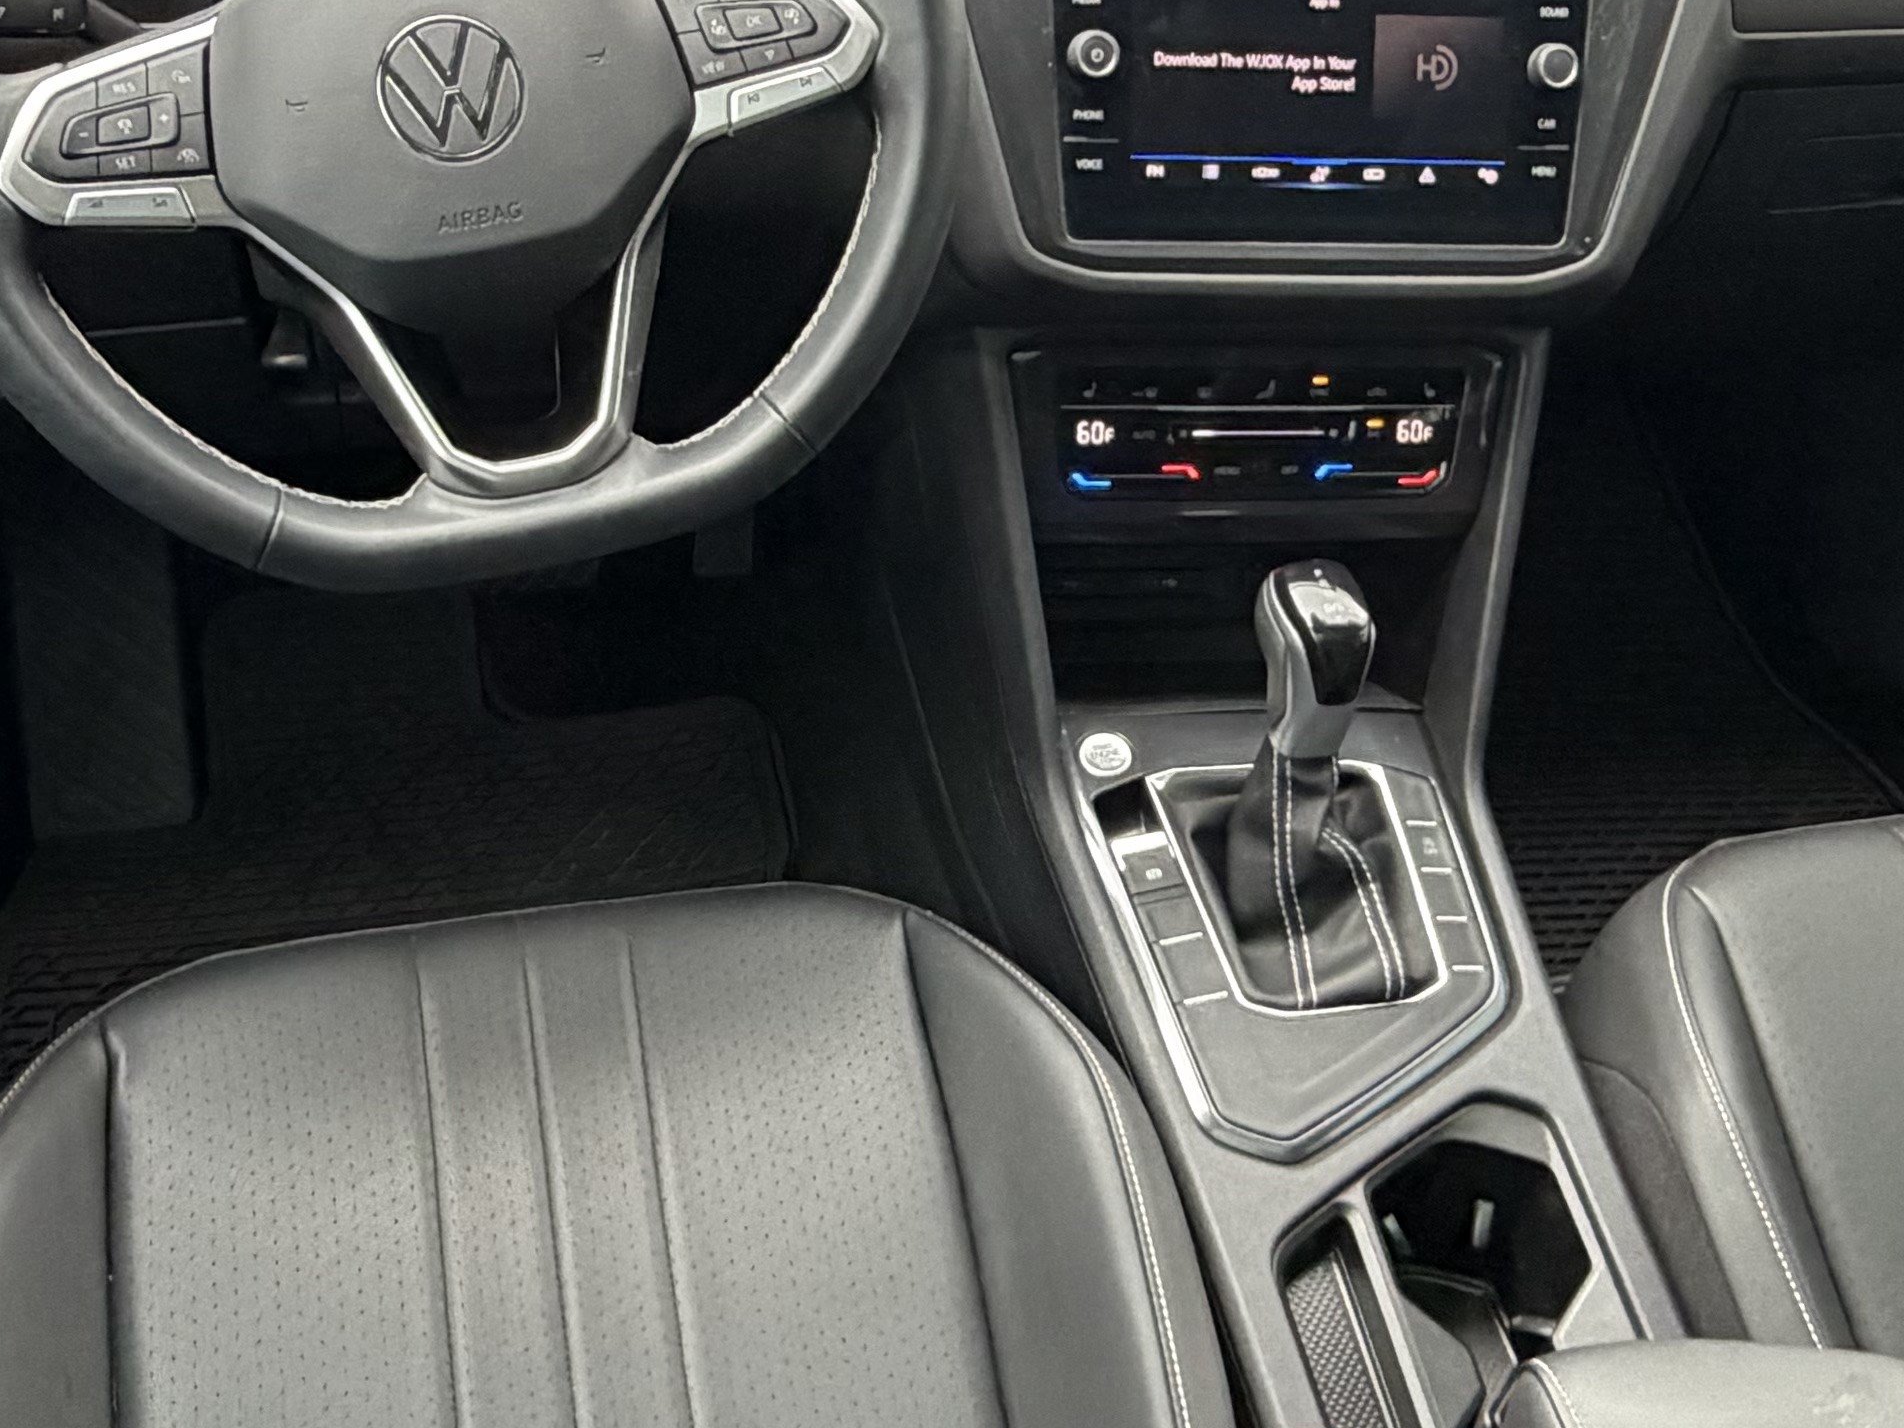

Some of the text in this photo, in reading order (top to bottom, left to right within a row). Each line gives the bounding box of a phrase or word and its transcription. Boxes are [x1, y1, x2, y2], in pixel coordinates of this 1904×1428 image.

[745, 13, 763, 28] OK
[1153, 50, 1218, 68] Download
[1219, 52, 1245, 69] The
[1285, 54, 1311, 73] App
[1313, 55, 1326, 71] In
[1327, 55, 1357, 72] Your
[1416, 48, 1455, 87] HD
[1291, 75, 1319, 94] App
[1072, 108, 1105, 121] PHONE
[1537, 117, 1557, 130] CAR
[114, 154, 137, 171] SET
[1075, 158, 1103, 171] VOICE
[437, 201, 525, 235] AIRBAG
